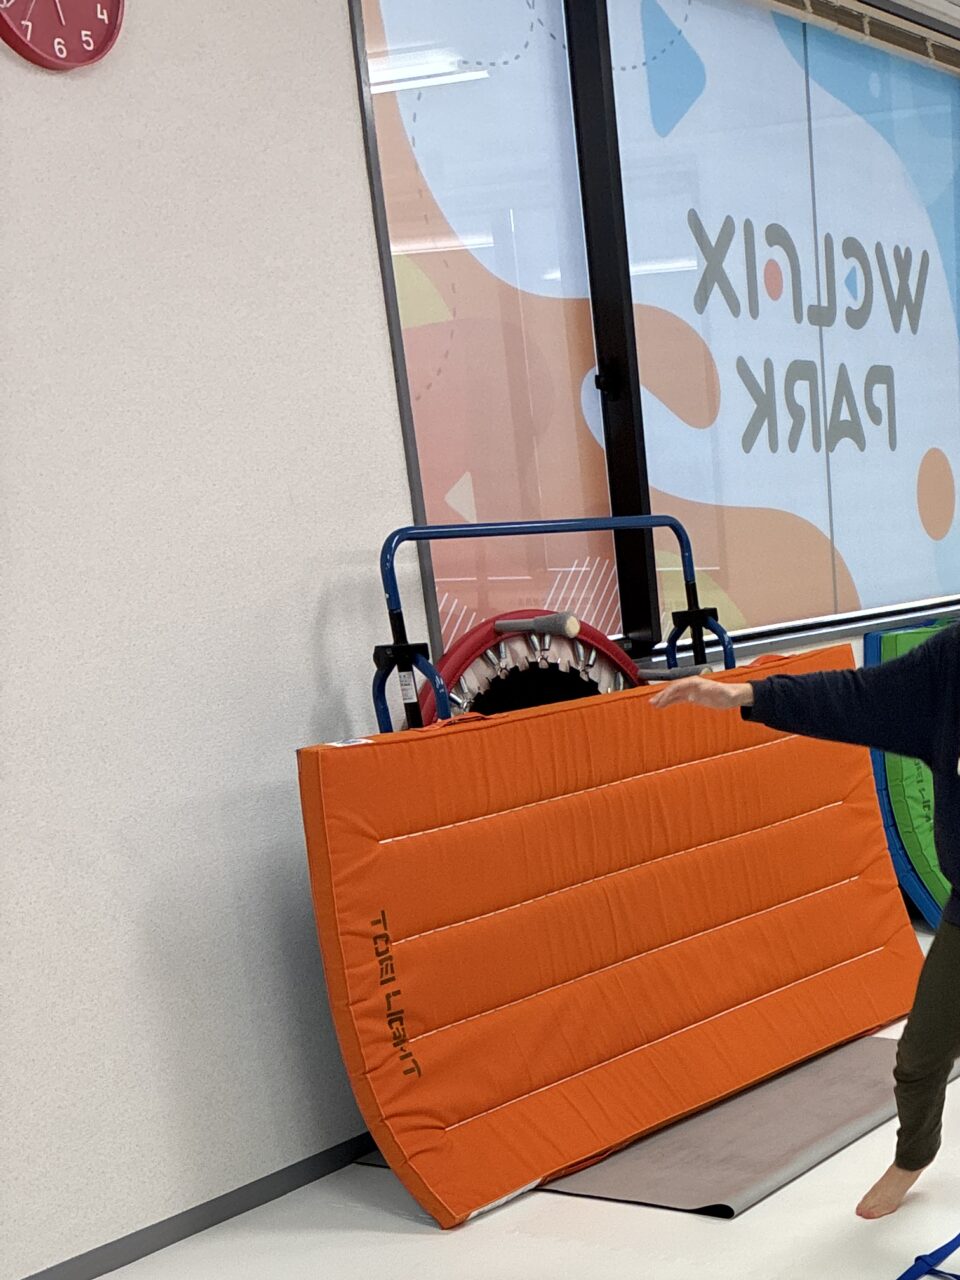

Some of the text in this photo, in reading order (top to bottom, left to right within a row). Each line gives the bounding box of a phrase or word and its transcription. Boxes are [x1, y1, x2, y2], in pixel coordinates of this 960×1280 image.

[97, 3, 109, 24] 4
[21, 20, 32, 41] 7
[80, 30, 94, 51] 5
[53, 37, 67, 58] 6
[370, 910, 422, 1078] TOEI LIGHT
